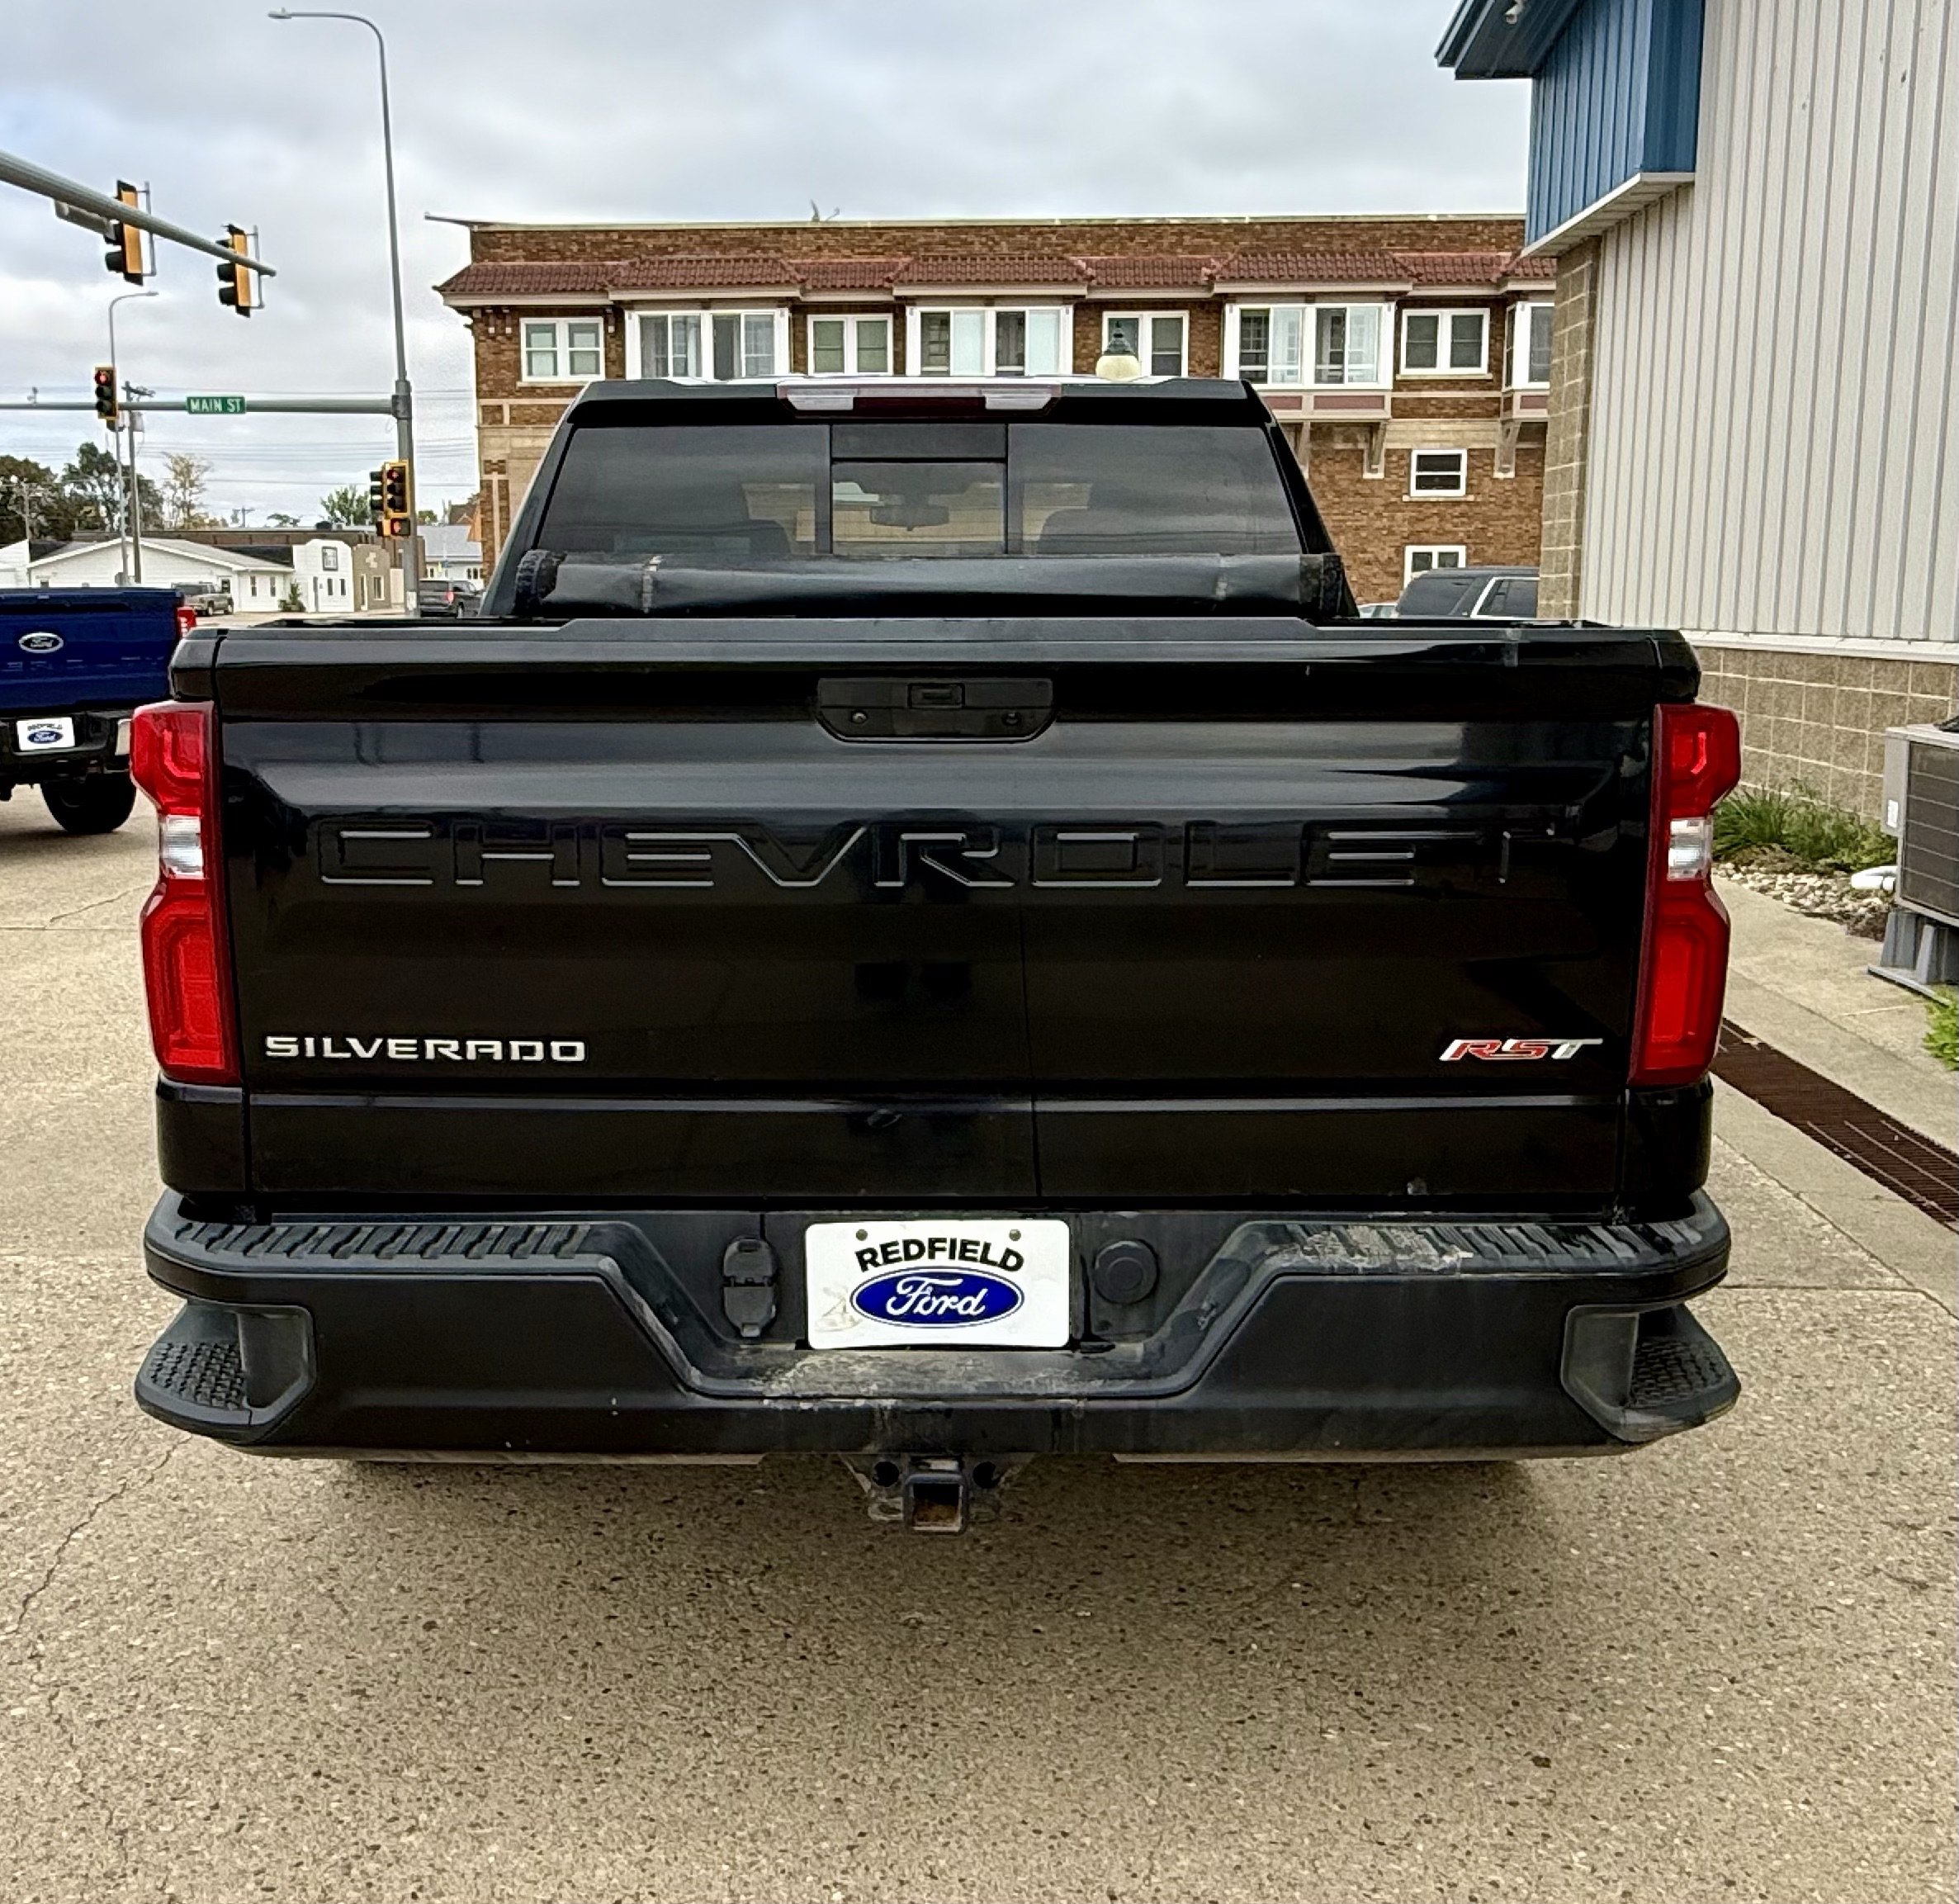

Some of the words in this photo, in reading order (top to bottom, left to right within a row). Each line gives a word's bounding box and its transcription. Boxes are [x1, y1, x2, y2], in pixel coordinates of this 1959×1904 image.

[191, 398, 222, 412] MAIN
[227, 398, 241, 412] ST
[265, 1036, 586, 1062] SILVERADO
[1439, 1038, 1603, 1061] RST
[855, 1238, 1024, 1272] REDFIELD
[886, 1276, 987, 1315] Ford
